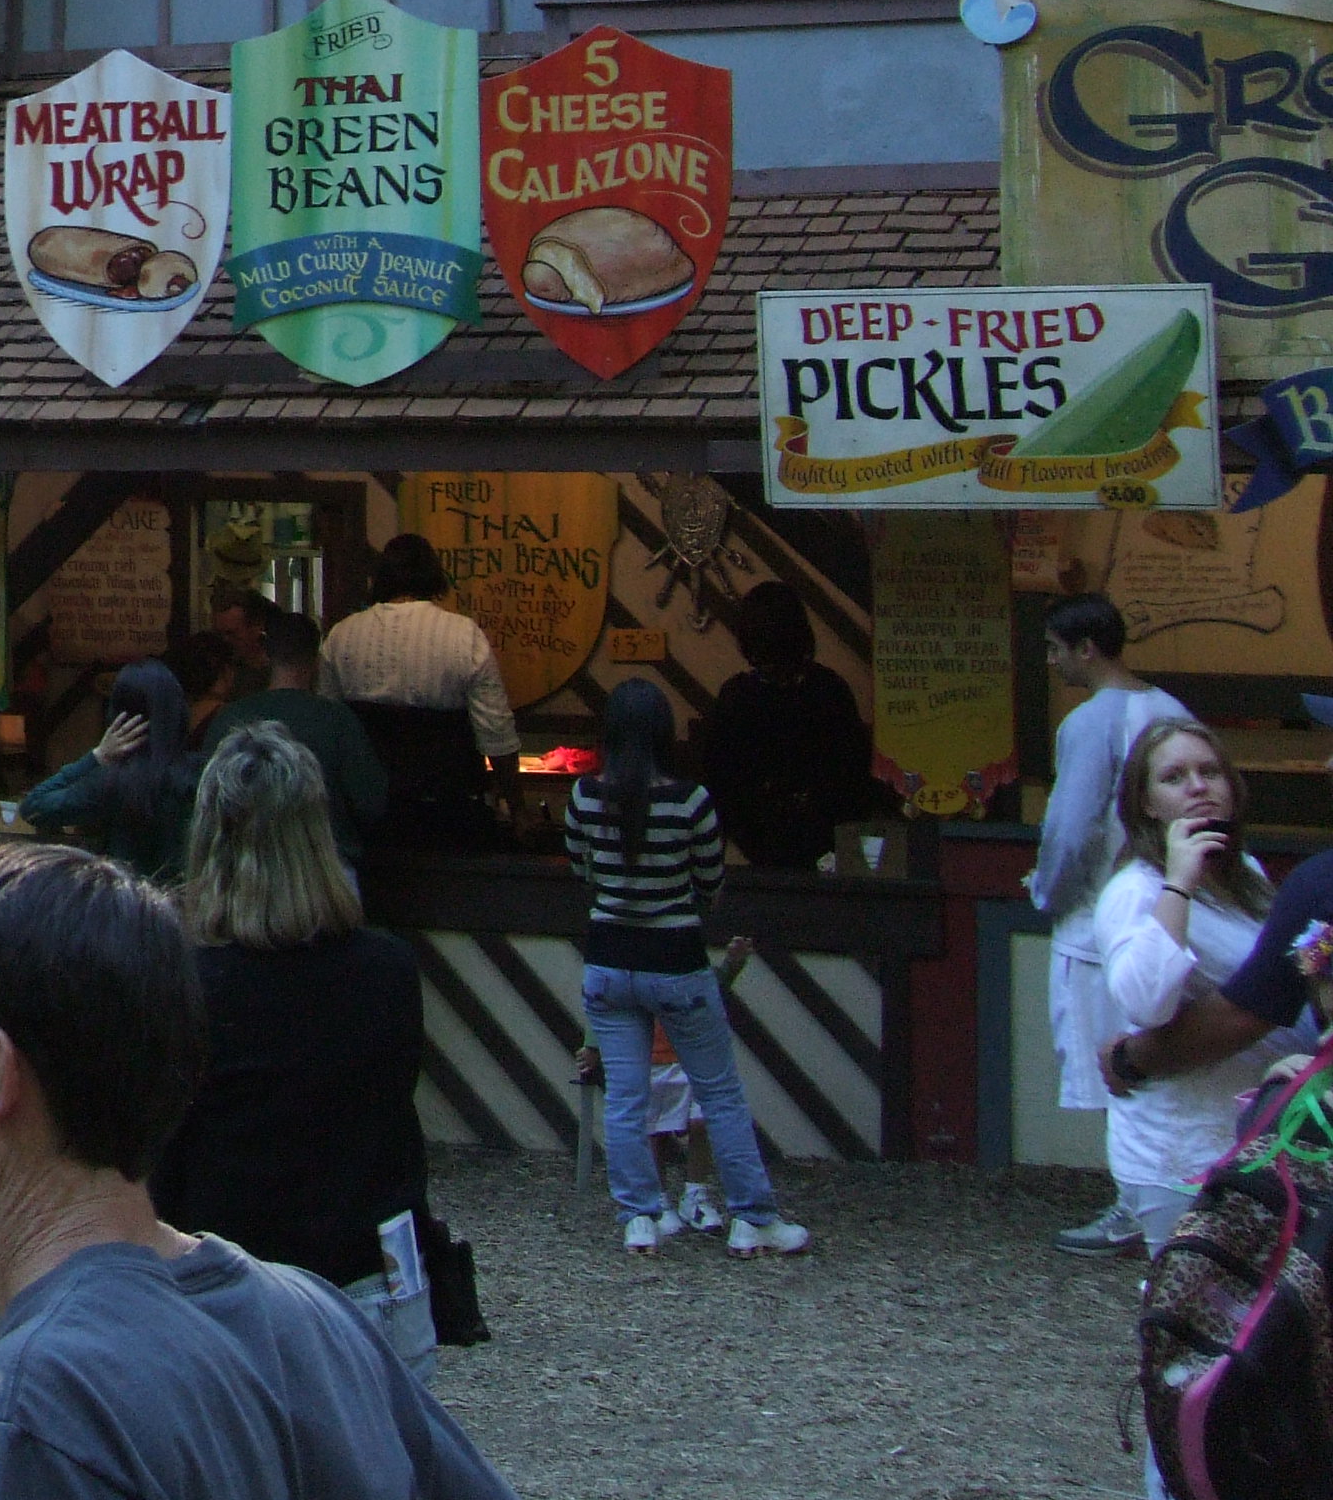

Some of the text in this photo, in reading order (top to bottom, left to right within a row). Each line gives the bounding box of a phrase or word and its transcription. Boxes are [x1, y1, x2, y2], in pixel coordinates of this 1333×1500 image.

[312, 15, 382, 56] FRIED
[582, 39, 620, 87] 5
[294, 72, 404, 108] THAI
[498, 85, 667, 133] CHEESE
[14, 98, 227, 146] MEATBALL
[265, 111, 440, 161] GREEN
[50, 145, 186, 227] WRAP
[267, 162, 447, 215] BEANS
[487, 142, 710, 204] CALAZONE
[314, 234, 383, 251] WITH A
[239, 251, 464, 289] MILD CURRY PEANUT
[260, 273, 449, 309] COCONUT SAUCE
[782, 350, 1068, 433] PICKLES
[855, 455, 914, 483] coated
[921, 441, 965, 469] with
[429, 479, 493, 512] FRIED
[444, 506, 560, 544] THAI
[436, 542, 601, 591] REEN BEANS
[455, 591, 503, 614] MILD
[485, 579, 536, 598] WITH
